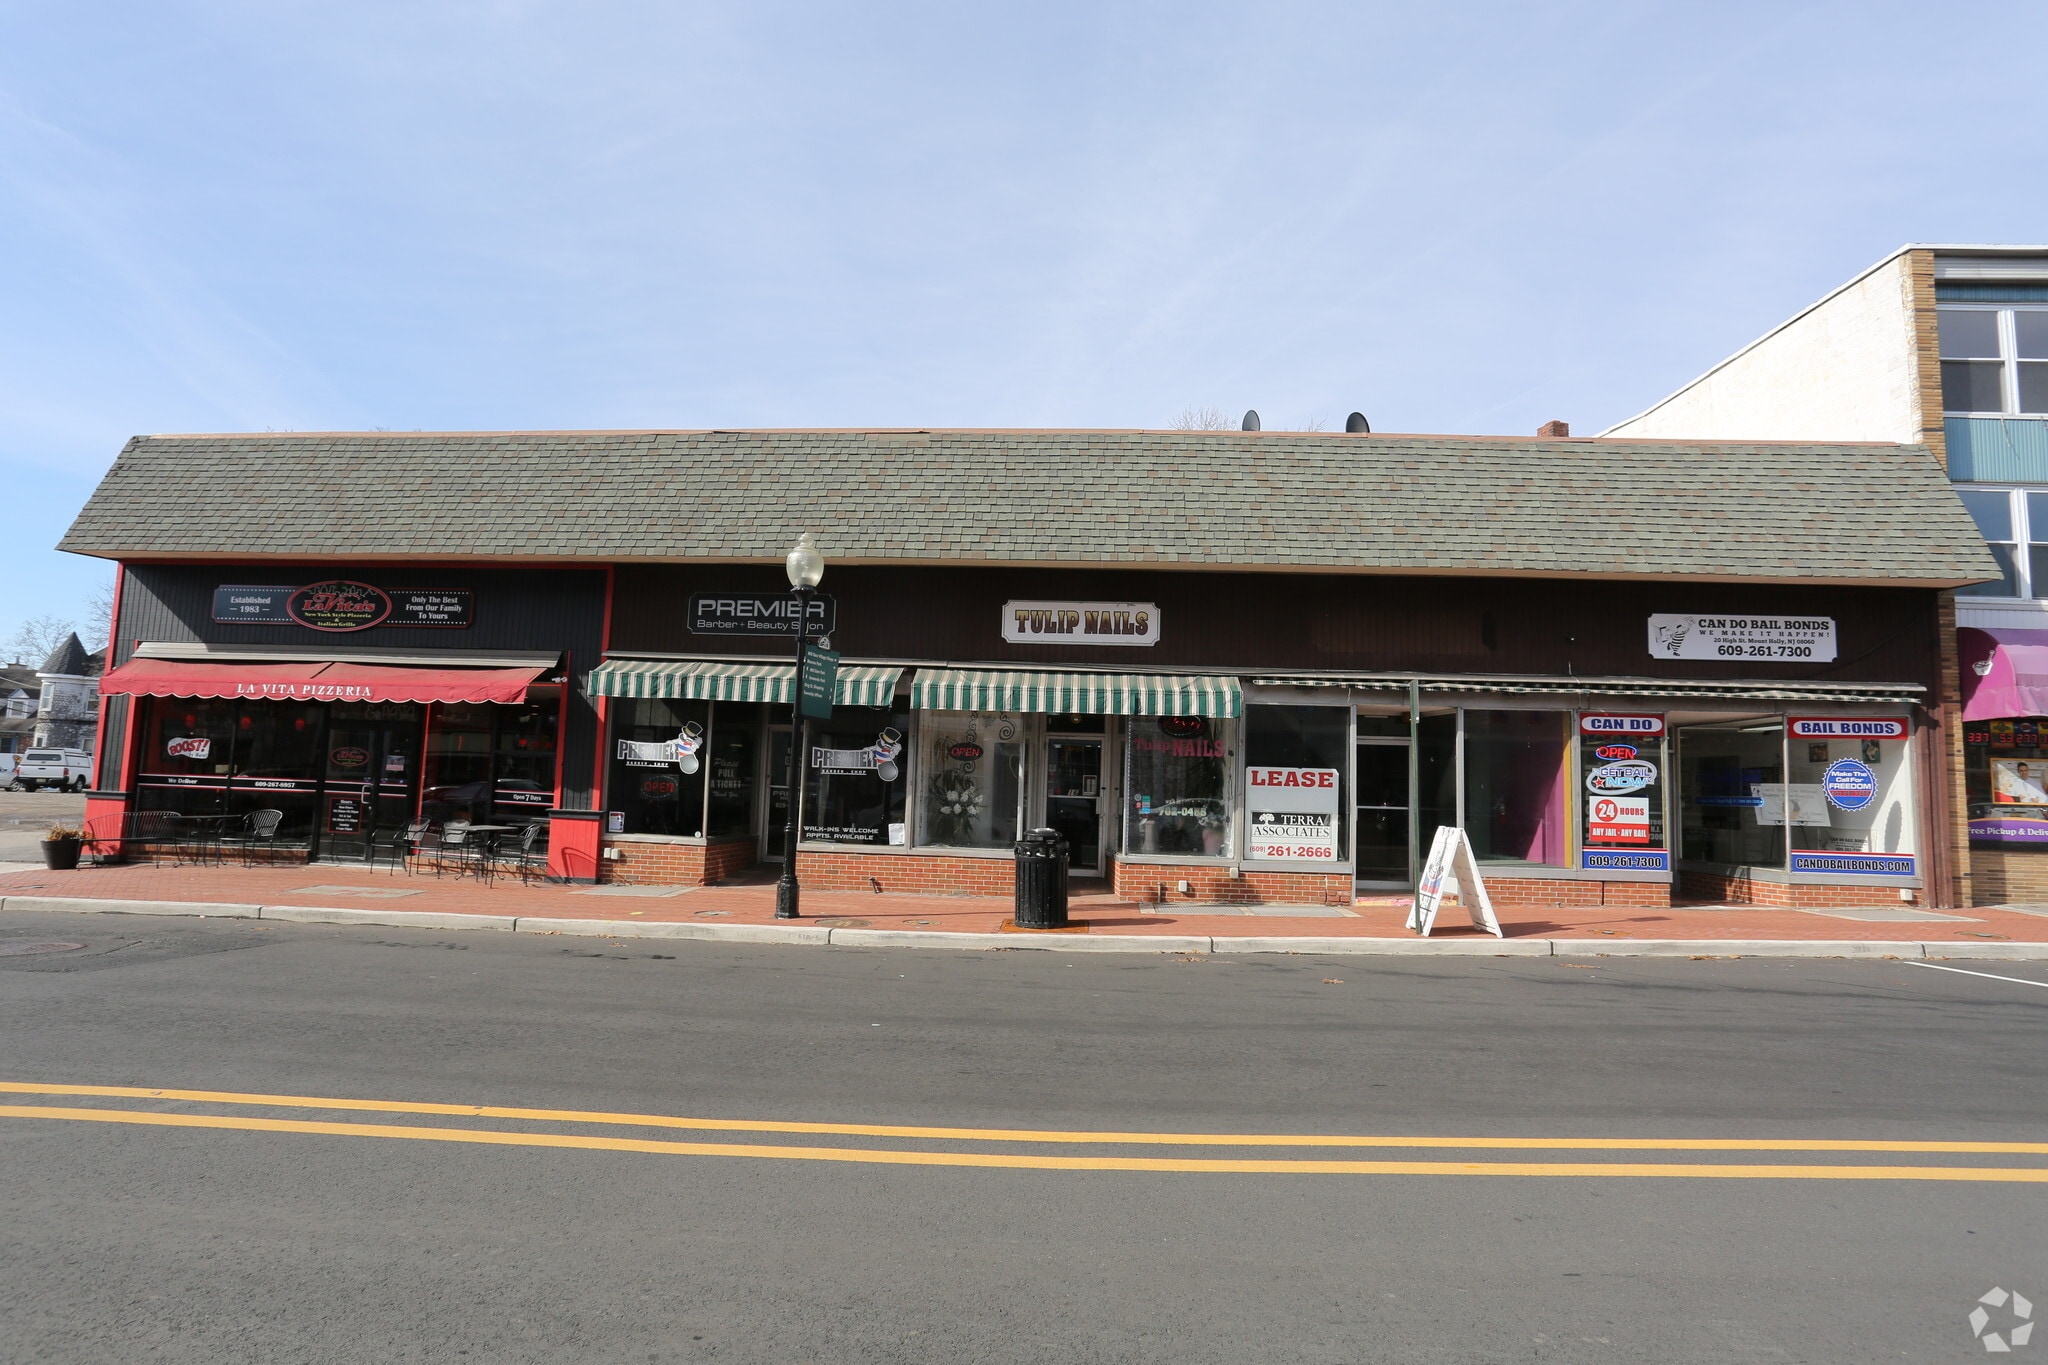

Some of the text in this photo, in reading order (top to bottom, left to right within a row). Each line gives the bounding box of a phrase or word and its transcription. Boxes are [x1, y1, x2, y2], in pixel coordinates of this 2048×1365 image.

[230, 596, 271, 604] Established
[411, 596, 427, 604] Only
[439, 605, 462, 613] Family
[697, 600, 825, 618] PREMIER
[697, 620, 738, 628] Barber
[747, 621, 788, 630] Beauty
[791, 622, 824, 630] Slon
[1014, 609, 1149, 636] TULIP NAILS
[1698, 619, 1830, 631] CAN DO BAIL BONDS
[1718, 645, 1812, 657] 609-261-7300
[237, 684, 372, 696] LA VITA PIZZERIA
[1590, 718, 1653, 730] CAN DO
[1801, 722, 1895, 734] BAIL BONDS
[169, 739, 209, 755] BOOST!
[951, 747, 980, 757] OPEN
[1134, 739, 1225, 757] Tulip NAILS
[1598, 746, 1635, 759] OPEN
[714, 758, 739, 767] Please
[718, 769, 735, 777] PULL
[1600, 767, 1650, 777] GET BAIL
[710, 780, 741, 789] A TICKET
[1251, 770, 1334, 788] LEASE
[1606, 777, 1648, 788] NOW
[644, 781, 676, 792] OPEN
[525, 794, 530, 802] 7
[1598, 803, 1645, 818] 24 HOURS
[1281, 814, 1324, 826] TERRA
[1253, 825, 1330, 838] ASSOCIATES
[1592, 828, 1604, 836] ANY
[1605, 828, 1617, 836] JAIL
[1621, 829, 1633, 837] ANY
[1633, 829, 1647, 838] BAIL
[1986, 827, 2017, 836] Pickup
[1249, 845, 1332, 858] (609) 261-2666
[1589, 855, 1662, 868] 609-261-7300
[1796, 858, 1910, 873] CANDOBAILBONDS.COM
